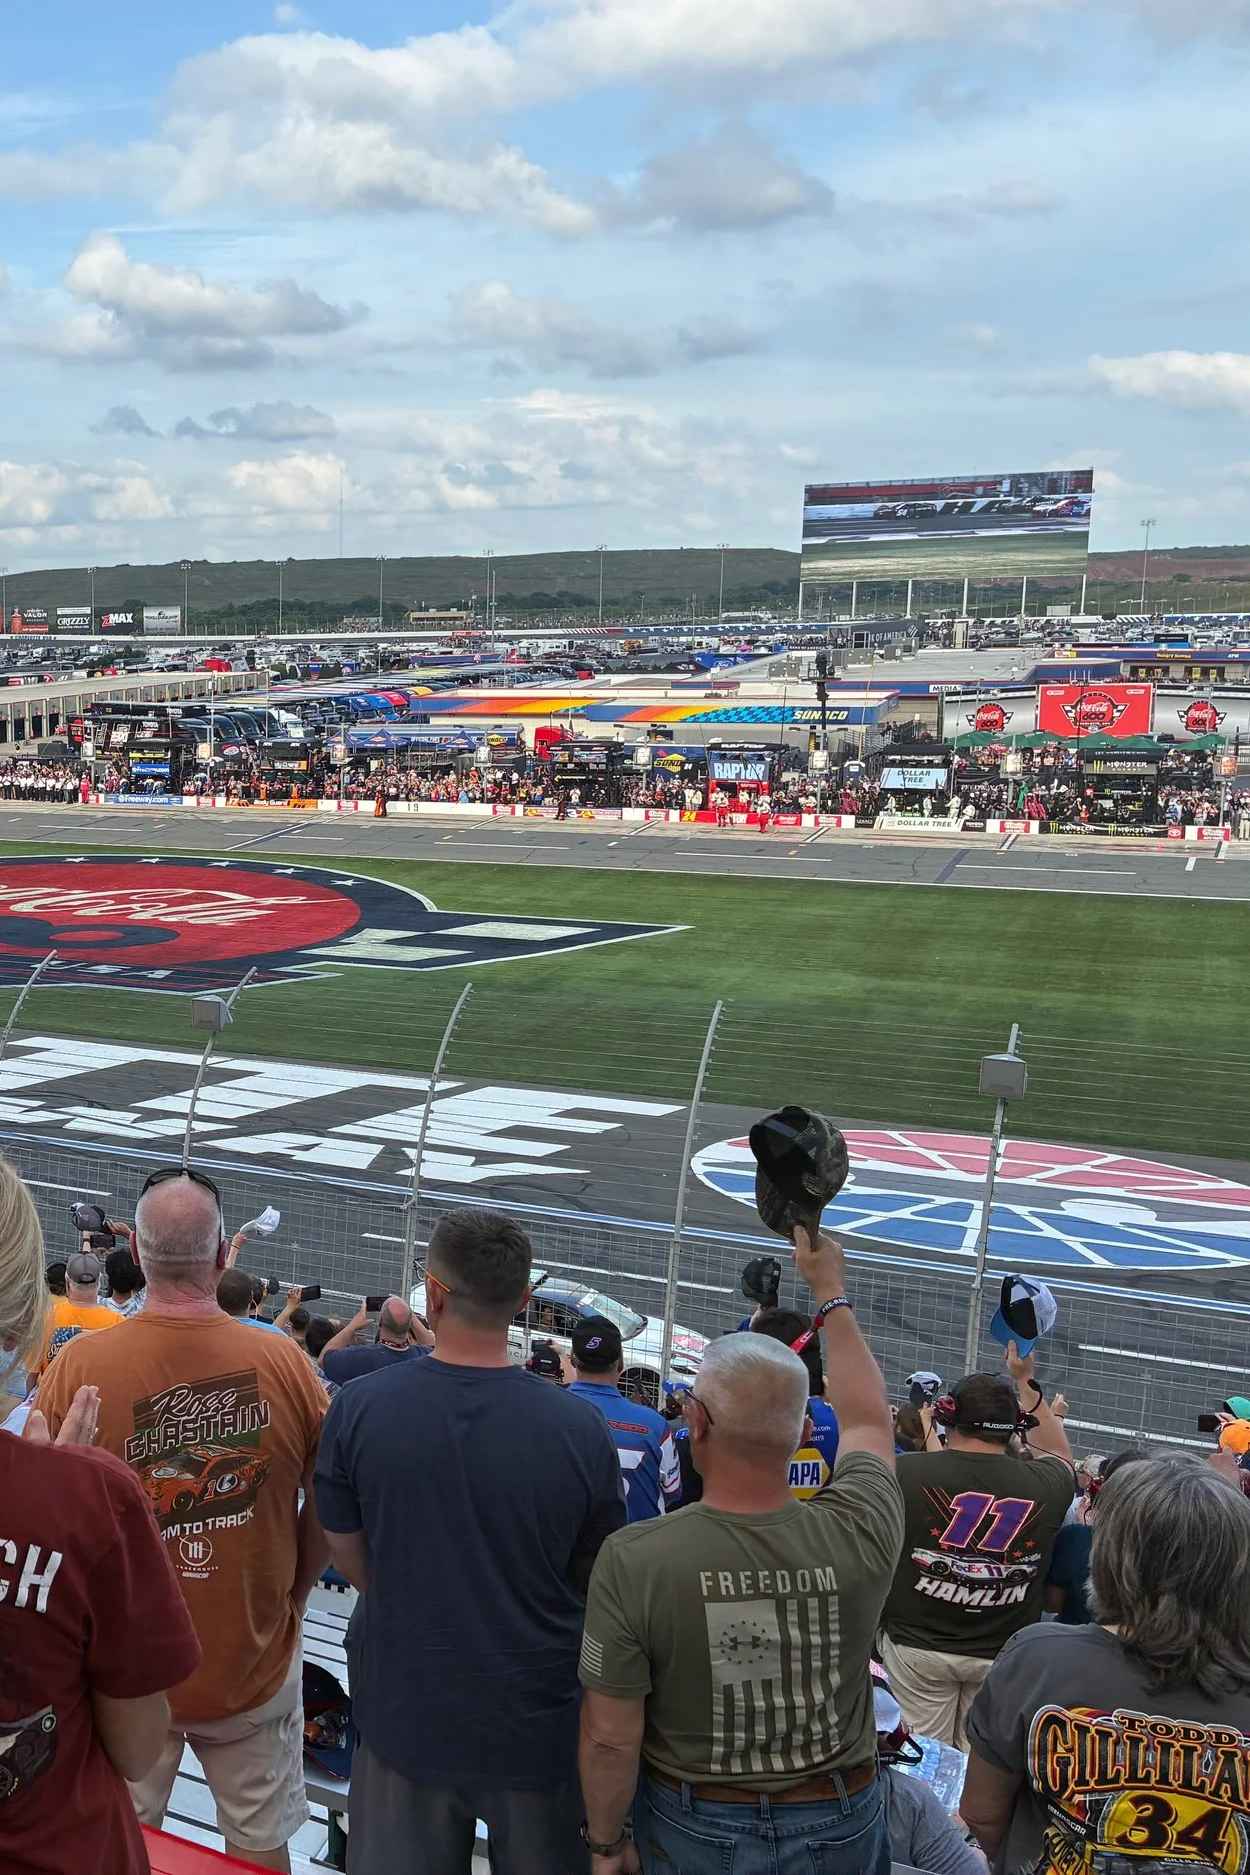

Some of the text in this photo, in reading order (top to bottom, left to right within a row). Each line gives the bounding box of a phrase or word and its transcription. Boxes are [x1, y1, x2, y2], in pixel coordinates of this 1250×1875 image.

[57, 617, 90, 626] GRIZZLY
[1077, 701, 1109, 712] Coca-Cola
[1188, 708, 1213, 718] Coca-Cola
[977, 711, 1001, 721] Coca-Cola
[980, 719, 997, 728] 600
[1081, 712, 1106, 721] 600
[714, 762, 765, 780] RAPTOR
[1106, 760, 1147, 768] MONSTER
[124, 795, 168, 804] Freeway.com
[682, 811, 697, 821] 24
[31, 960, 175, 979] USA
[586, 1337, 603, 1350] 5
[150, 1383, 237, 1426] Ross
[124, 1400, 271, 1463] CHASTAIN
[982, 1421, 1014, 1430] RUGGED
[788, 1461, 822, 1487] APA
[185, 1521, 203, 1535] TO
[205, 1506, 254, 1529] TRACK
[938, 1491, 1035, 1553] 11
[951, 1559, 1004, 1578] FedEx 11
[698, 1566, 838, 1597] FREEDOM
[914, 1576, 1031, 1607] HAMLIN
[1118, 1713, 1239, 1747] TODD
[1114, 1793, 1233, 1866] 34
